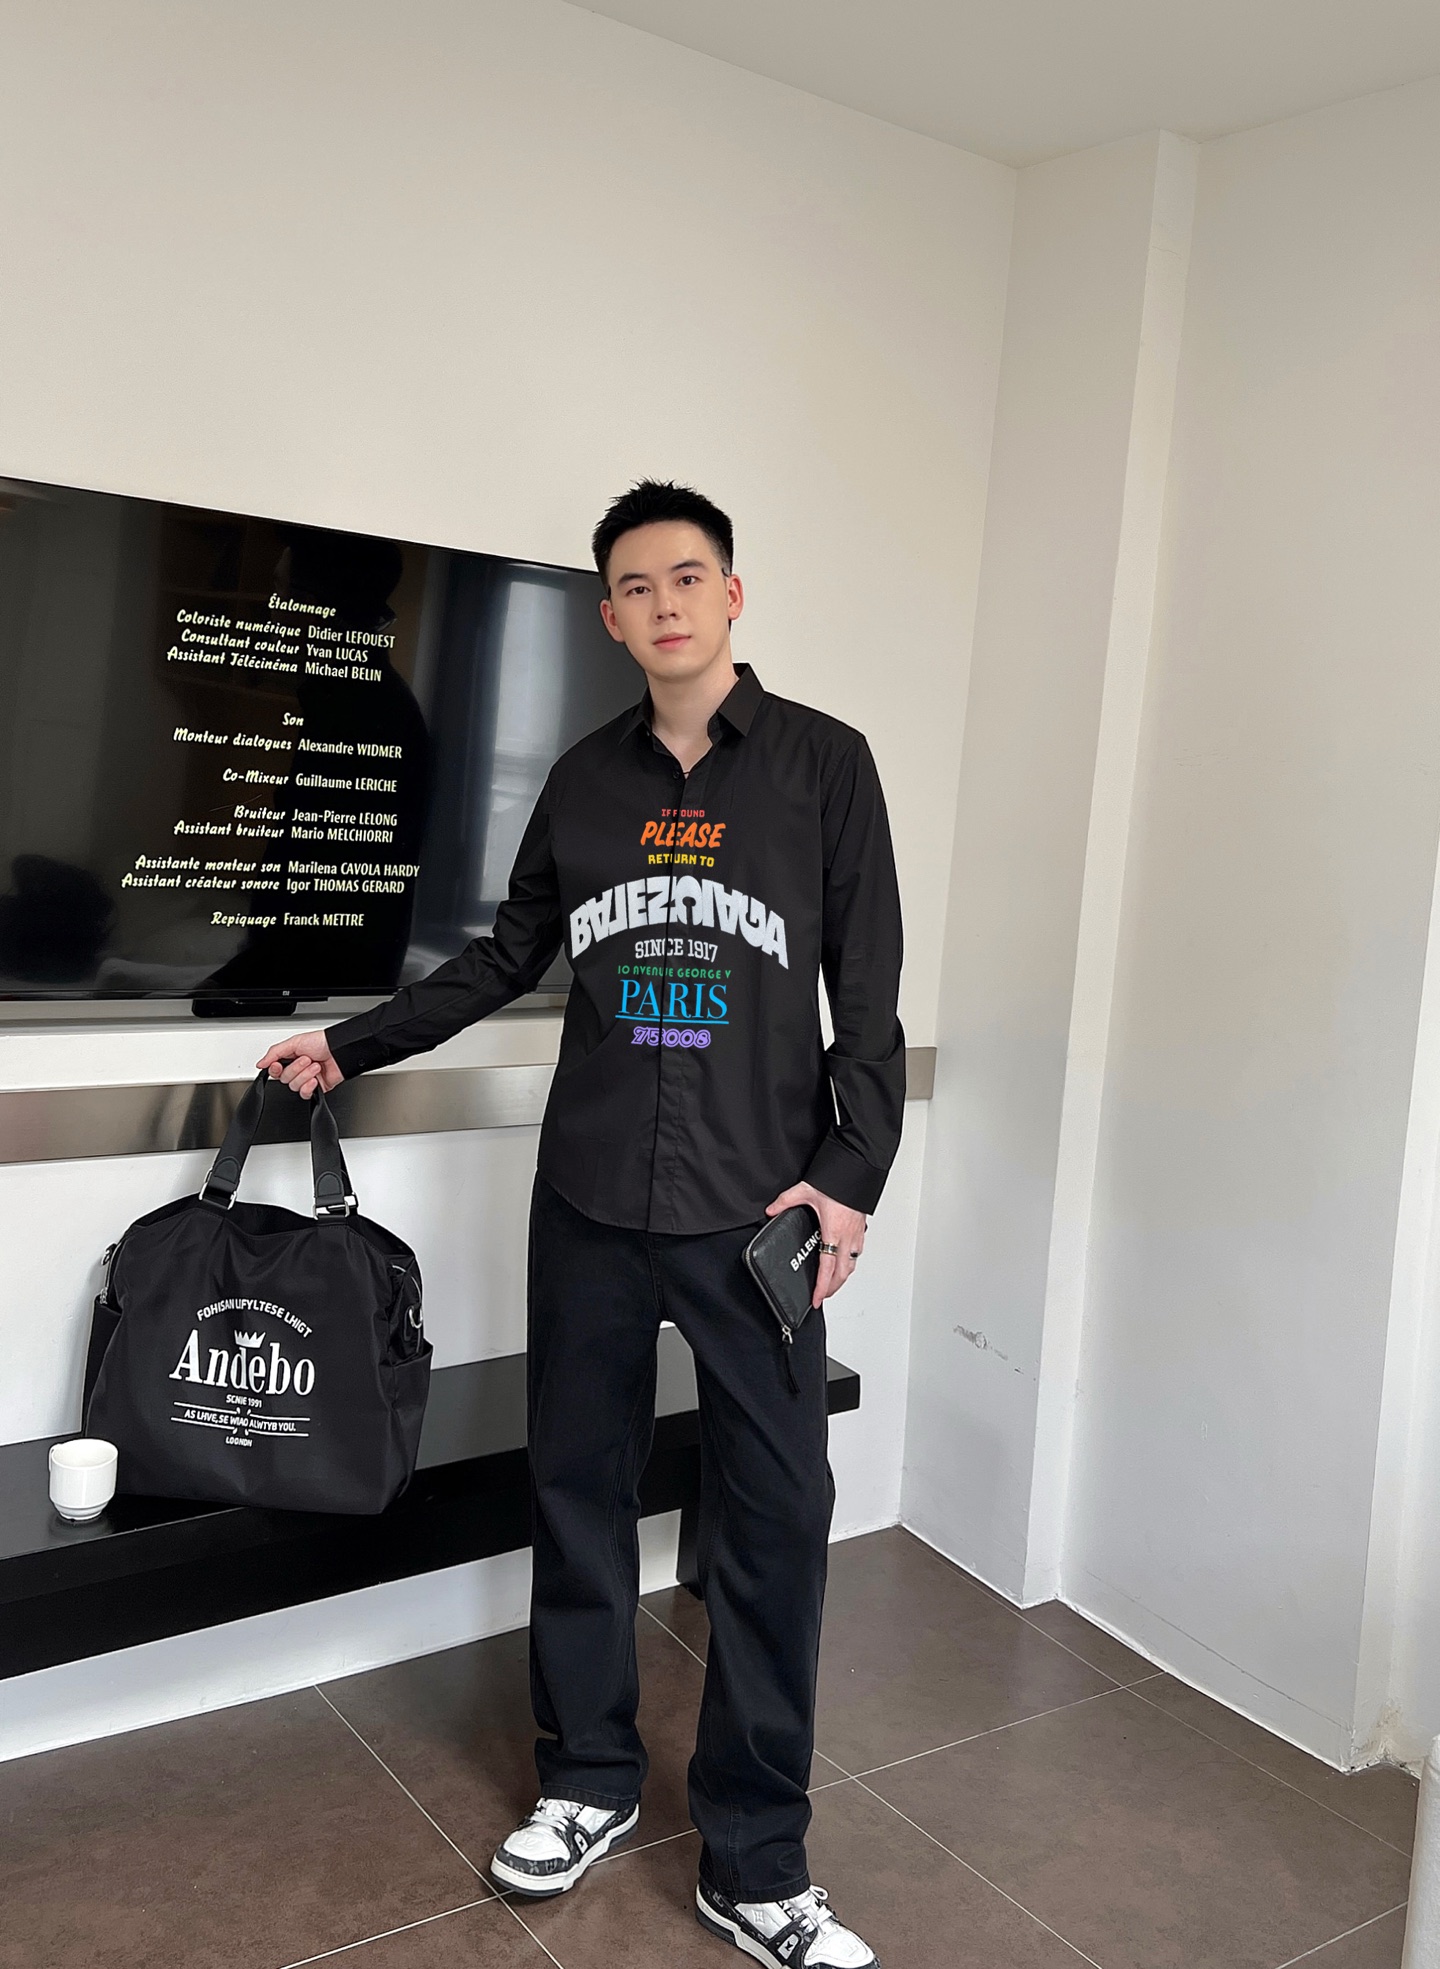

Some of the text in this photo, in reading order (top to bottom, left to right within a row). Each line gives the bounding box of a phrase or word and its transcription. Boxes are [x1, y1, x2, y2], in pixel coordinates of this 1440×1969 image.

[268, 592, 336, 619] Étalonnage
[176, 609, 396, 649] Coloriste numérique Didier LEFOUEST
[181, 628, 368, 663] Consultant couleur Yvan LUCAS
[166, 646, 382, 682] Assistant Télécinéma Michael BELIN
[282, 712, 304, 726] Son
[173, 727, 402, 759] Monteur dialogues Alexandre WIDMER
[222, 768, 398, 792] Co-Mixeur Guillaume LERICHE
[234, 805, 398, 826] Bruiteur Jean-Pierre LELONG
[673, 810, 705, 818] FOUND
[174, 820, 394, 843] Assistant bruiteur Mario MELCHIORRI
[640, 821, 726, 848] PLEASE
[135, 855, 420, 878] Assistante monteur son Marilena CAVOLA HARDY
[648, 854, 714, 867] RETURN TO
[122, 872, 404, 894] Assistant créateur sonore Igor THOMAS GERARD
[210, 911, 364, 928] Repiquage Franck METTRE
[635, 938, 718, 962] SINCE 1917
[633, 966, 674, 978] AVENUE
[677, 968, 721, 979] GEORGE
[725, 970, 731, 978] V
[618, 980, 728, 1019] PARIS
[631, 1026, 711, 1048] 75008
[284, 1312, 312, 1338] LHIGT
[168, 1329, 315, 1396] Andebo
[184, 1409, 196, 1418] AS
